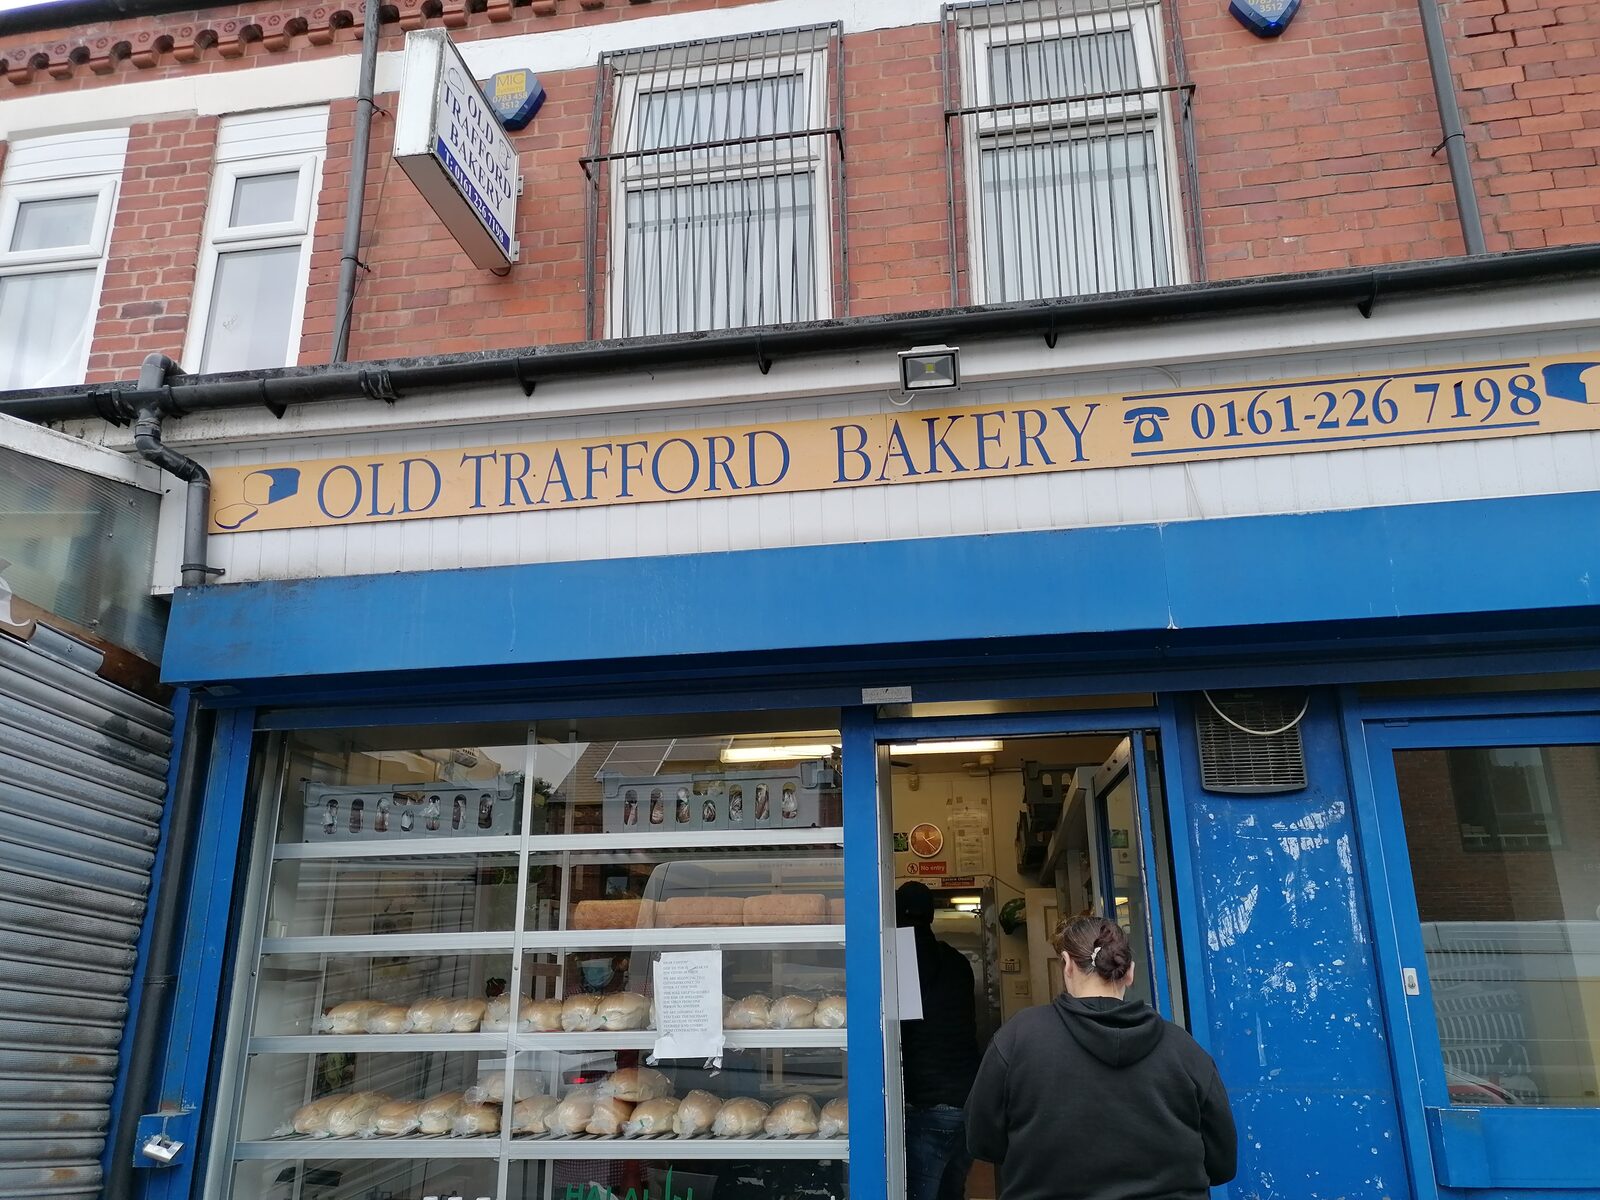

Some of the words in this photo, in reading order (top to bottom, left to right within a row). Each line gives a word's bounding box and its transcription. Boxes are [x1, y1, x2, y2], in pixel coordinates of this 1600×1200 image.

[1260, 2, 1283, 12] 3512
[444, 80, 511, 199] TRAFFORD
[467, 94, 494, 145] OLD
[450, 120, 503, 212] BAKERY
[454, 163, 472, 198] 0161
[473, 193, 487, 218] 226
[487, 211, 504, 243] 7198
[317, 457, 442, 519] OLD
[459, 429, 791, 508] TRAFFORD
[830, 402, 1101, 484] BAKERY
[1190, 378, 1399, 440] 0161-226
[1414, 373, 1542, 423] 7198
[930, 864, 946, 872] entry
